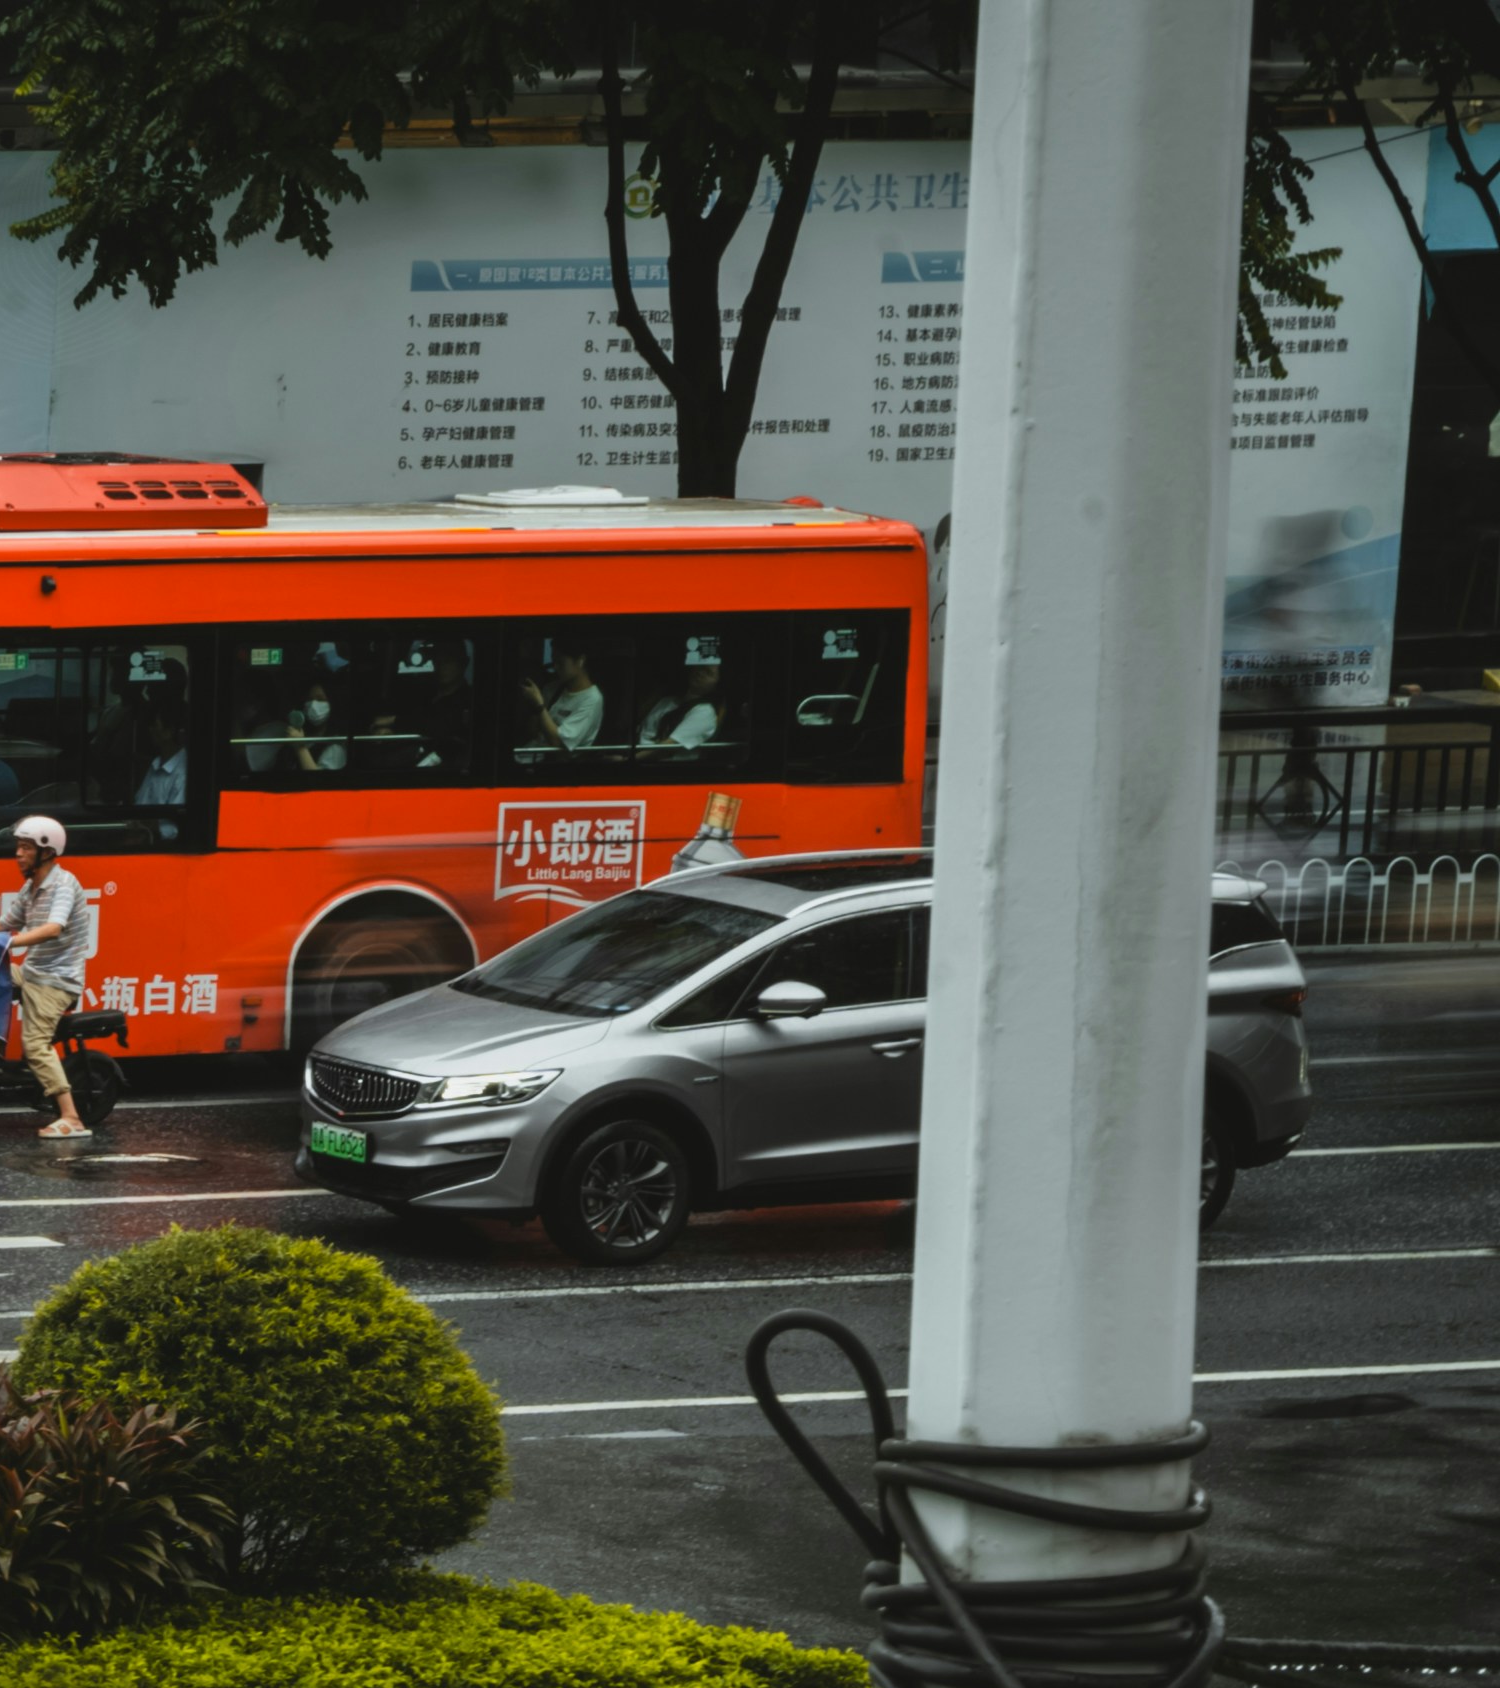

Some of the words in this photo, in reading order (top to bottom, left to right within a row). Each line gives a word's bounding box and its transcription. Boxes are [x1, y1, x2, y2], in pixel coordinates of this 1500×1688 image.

[879, 304, 964, 319] 13、健康素养
[1268, 315, 1336, 331] 神经管缺陷
[877, 328, 963, 343] 14、基本避孕
[406, 342, 481, 357] 2、健康教育
[404, 370, 480, 385] 3、预防接种
[400, 426, 516, 442] 5、孕产妇健康管理
[397, 454, 514, 470] 6、老年人健康管理
[505, 818, 635, 867] 小郎酒
[527, 868, 558, 880] Little
[562, 868, 593, 882] Lang
[595, 867, 631, 882] Baijiu
